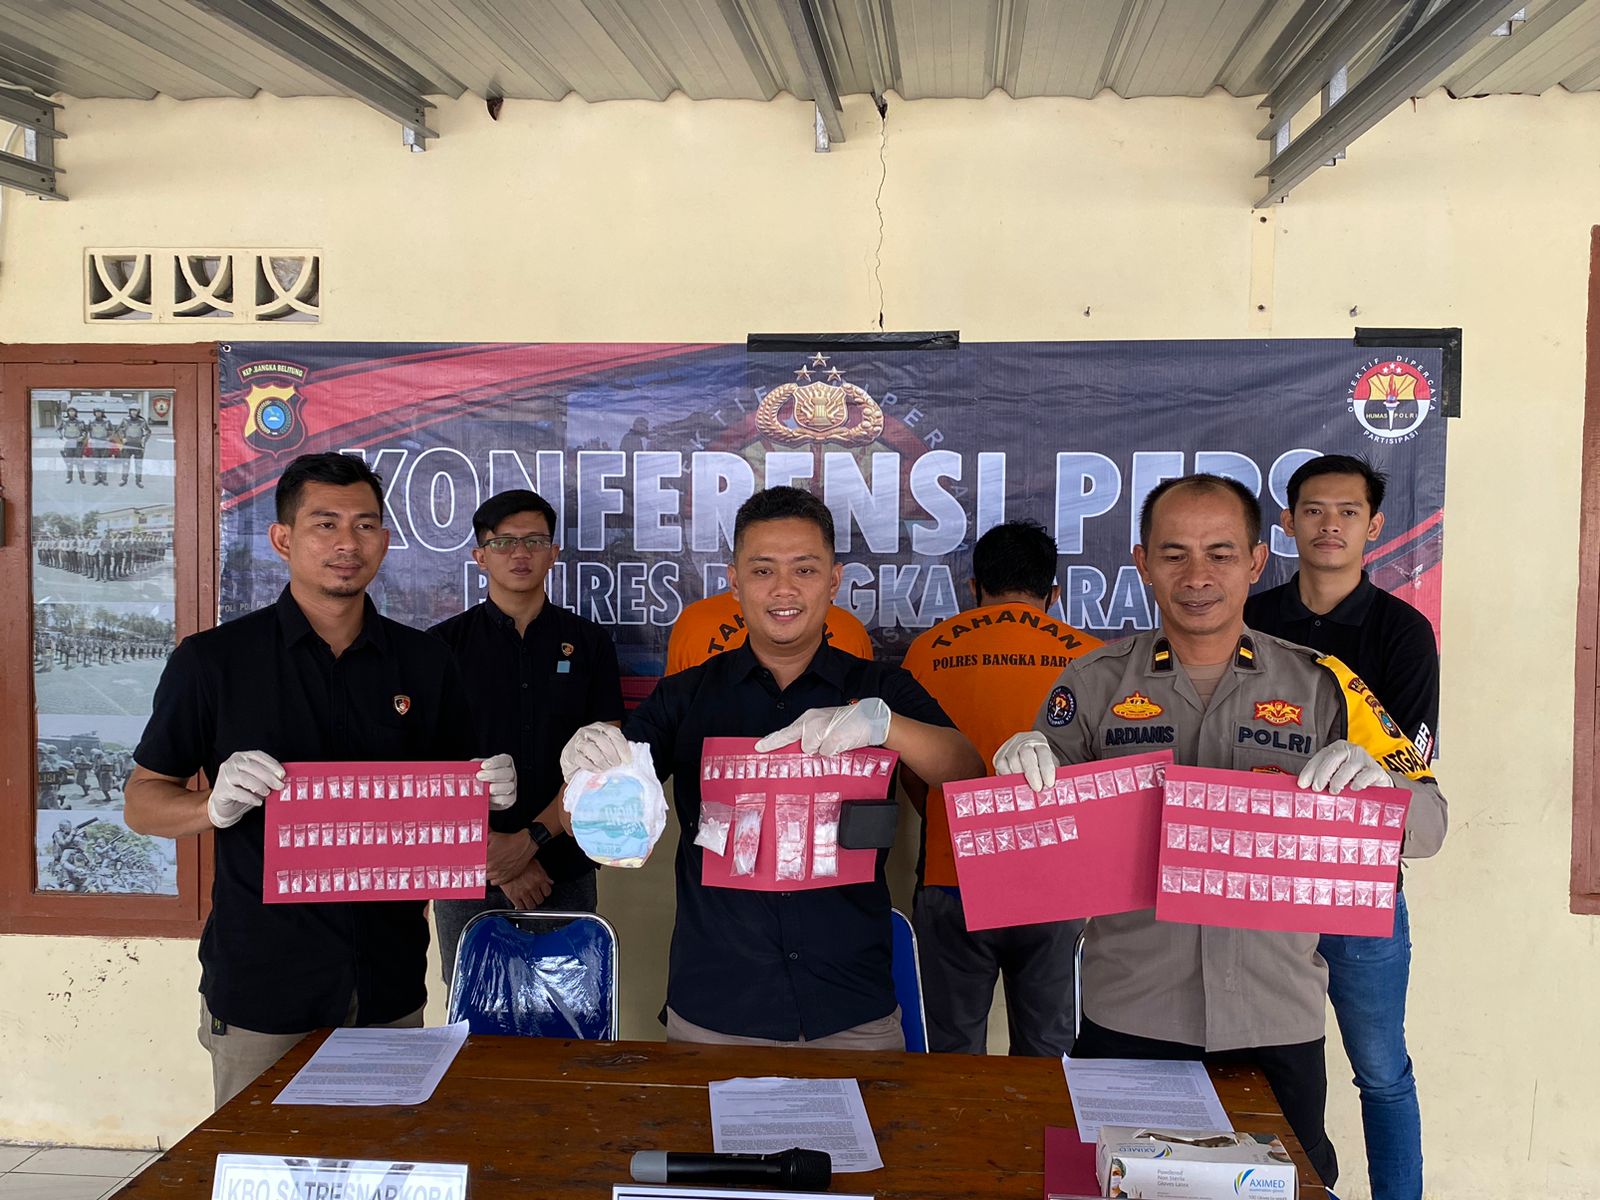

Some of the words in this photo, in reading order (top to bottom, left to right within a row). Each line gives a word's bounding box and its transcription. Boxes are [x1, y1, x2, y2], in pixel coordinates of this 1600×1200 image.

[1347, 358, 1379, 413] OBYEKTIF
[1396, 355, 1437, 411] DIPERCAYA
[1363, 430, 1419, 444] PARTISIPASI
[464, 561, 683, 627] PLRES
[932, 610, 1083, 650] TAHANAN
[932, 654, 978, 671] POLRES
[982, 654, 1036, 666] BANGKA
[1040, 655, 1077, 667] BAR
[1105, 726, 1175, 746] ARDIANIS
[1238, 726, 1312, 754] POLRI
[1377, 745, 1427, 776] ATGAS
[228, 1178, 270, 1200] KBO
[1249, 1179, 1286, 1189] AXIMED
